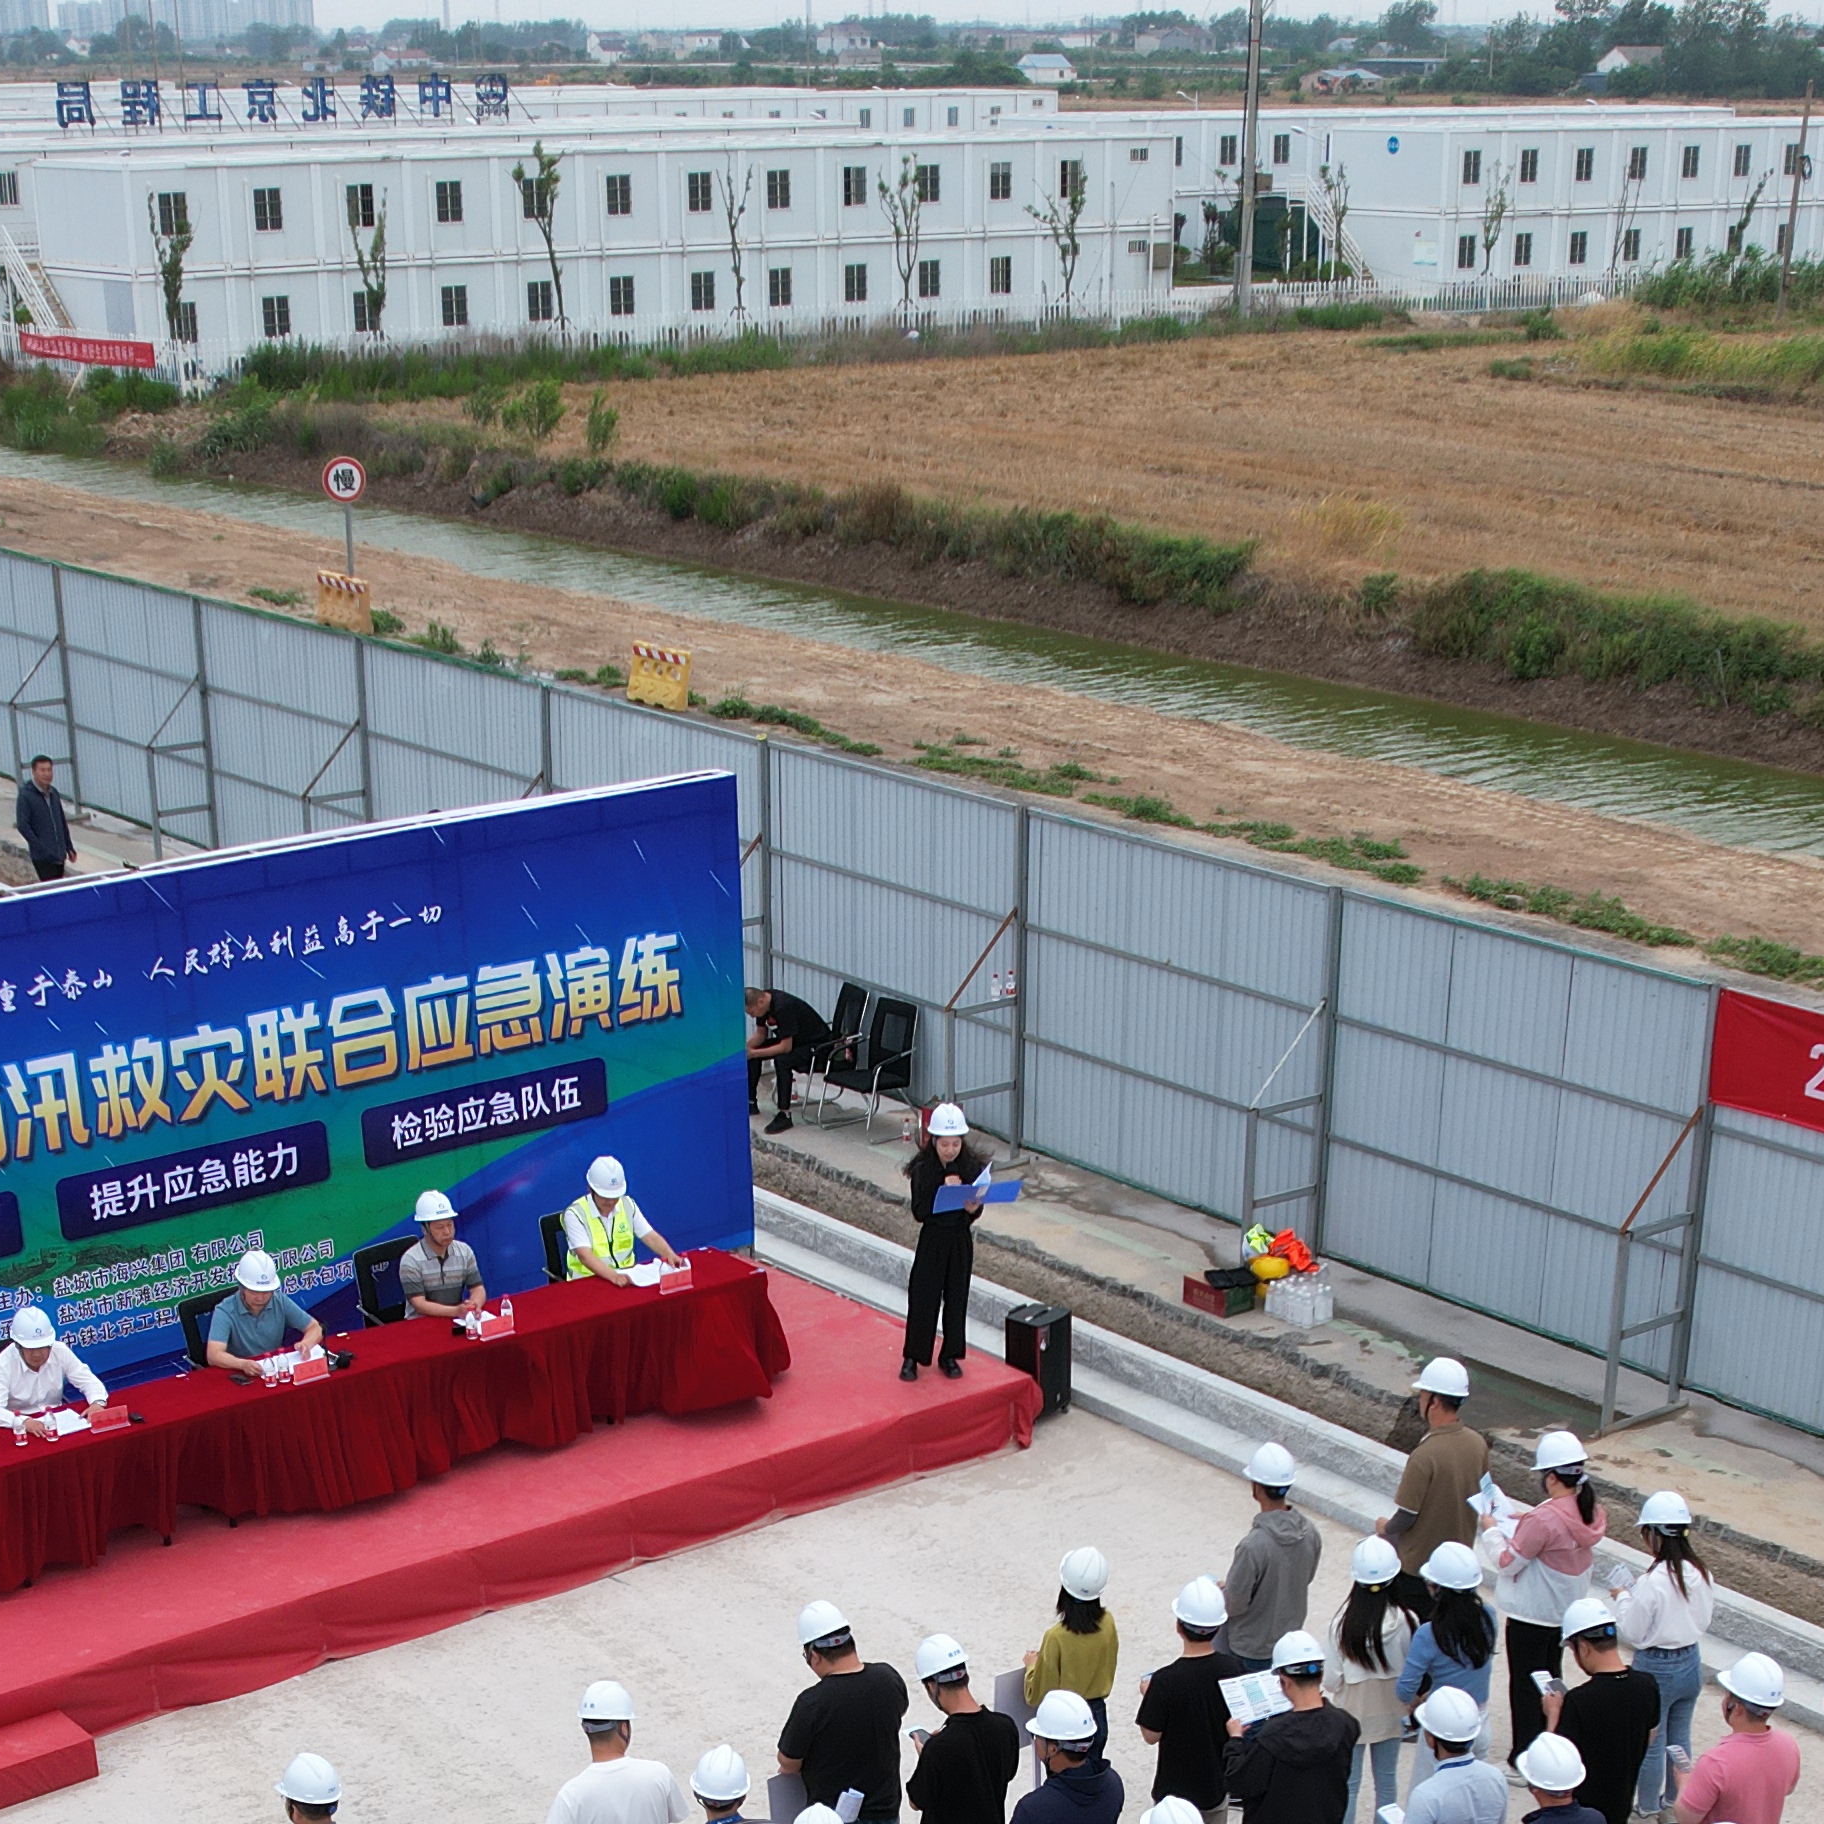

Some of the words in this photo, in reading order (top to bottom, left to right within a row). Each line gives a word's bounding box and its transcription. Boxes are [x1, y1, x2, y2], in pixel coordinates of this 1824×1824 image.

[333, 468, 356, 492] 慢
[150, 905, 444, 982] 人民群众利益高于一切
[388, 1077, 585, 1151] 检验应急队伍
[86, 1141, 303, 1222] 提升应急能力
